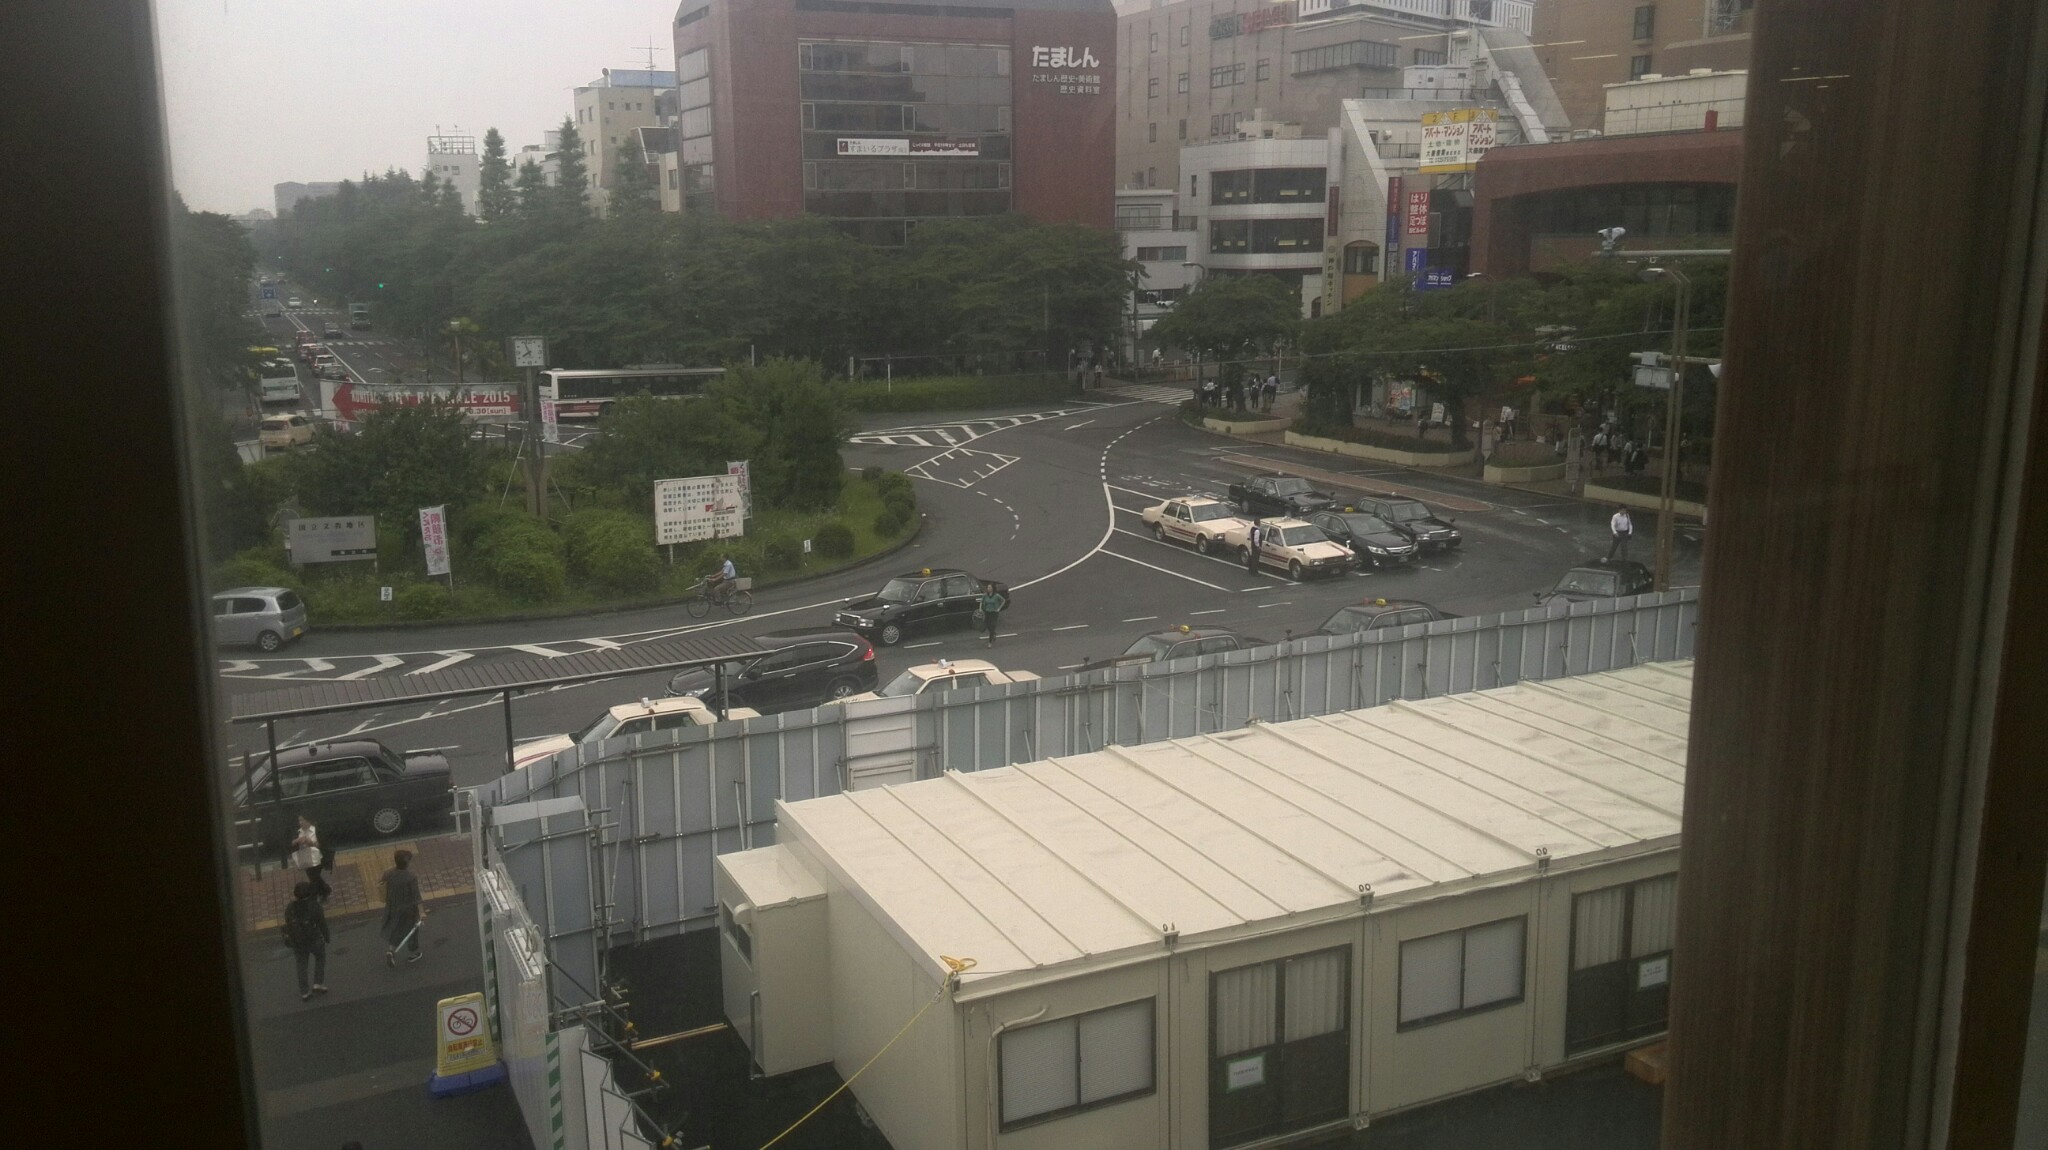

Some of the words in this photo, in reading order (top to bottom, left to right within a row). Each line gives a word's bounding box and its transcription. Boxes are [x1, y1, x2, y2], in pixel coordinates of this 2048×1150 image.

[1032, 46, 1100, 68] たましん
[1472, 123, 1492, 134] アパート
[1469, 135, 1494, 146] マンション
[1410, 193, 1428, 203] はり
[1409, 204, 1428, 215] 整体
[1408, 215, 1428, 226] 足つぼ
[483, 390, 511, 404] 2015
